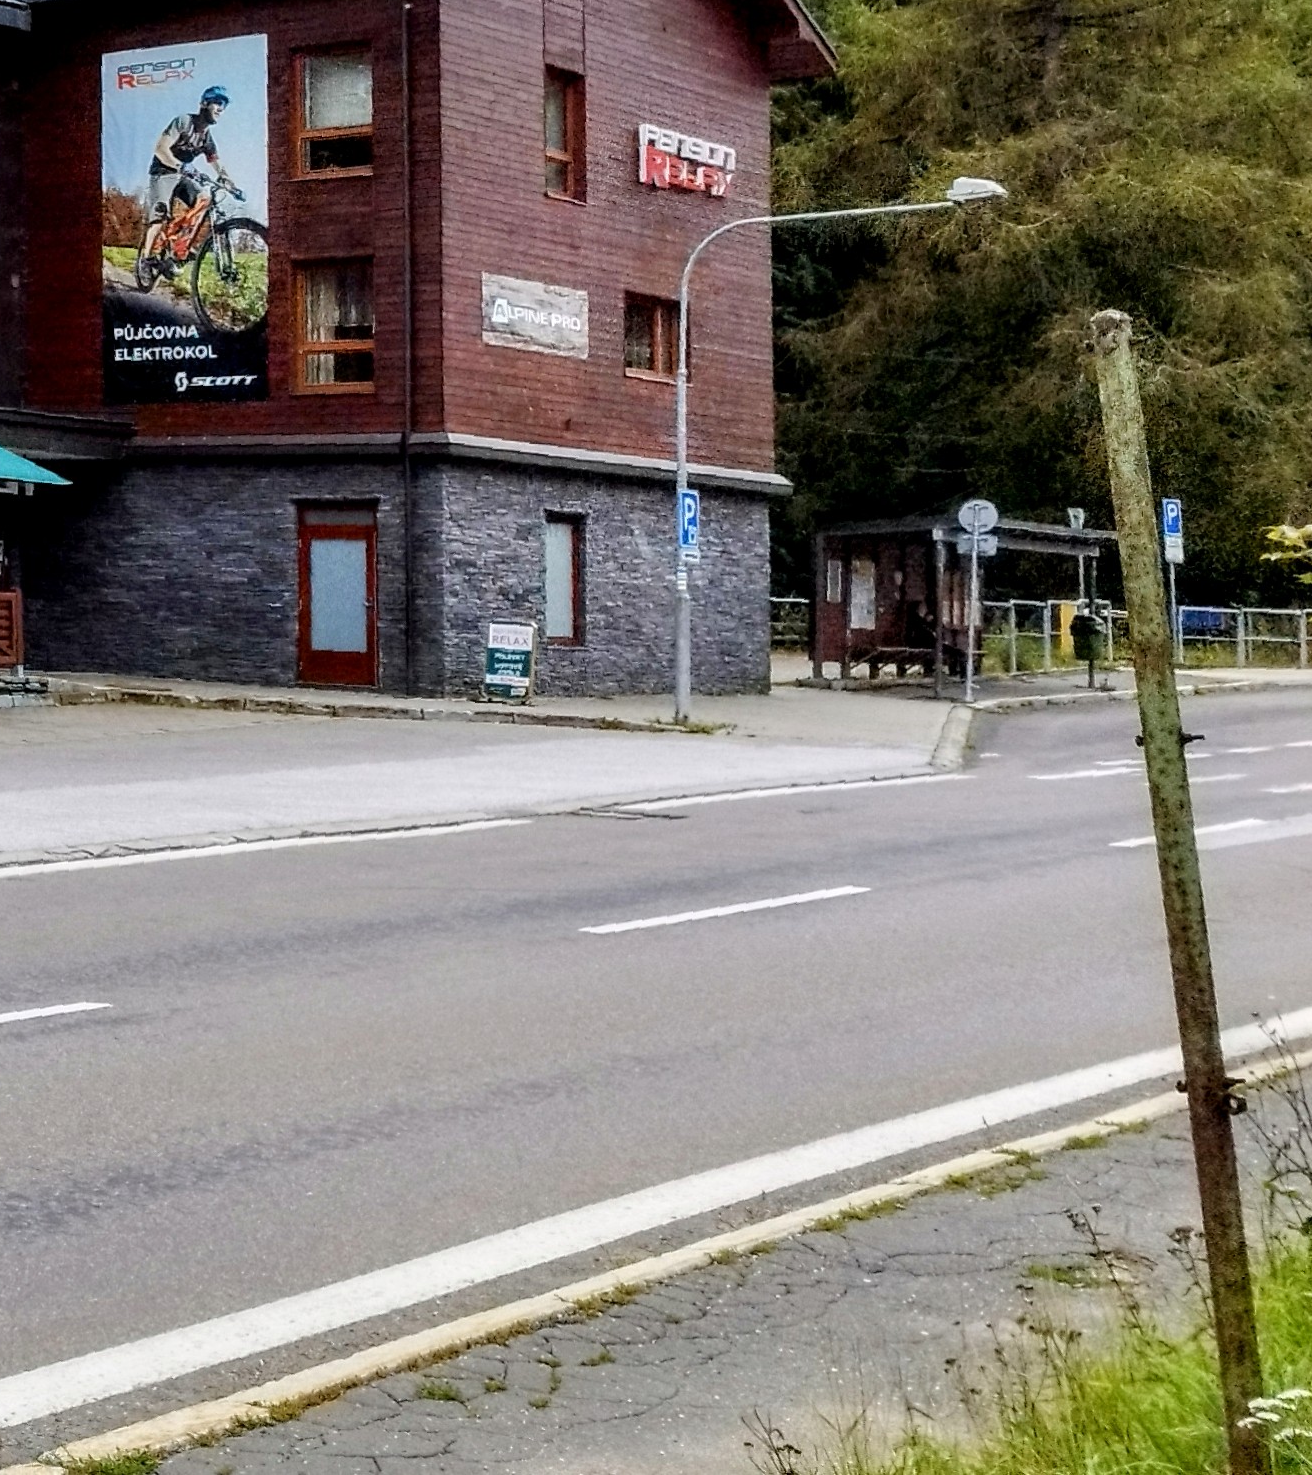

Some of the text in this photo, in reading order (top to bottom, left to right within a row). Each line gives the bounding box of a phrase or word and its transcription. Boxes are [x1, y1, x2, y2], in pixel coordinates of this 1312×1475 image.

[117, 58, 195, 75] PENSION
[117, 70, 194, 90] RELAX
[639, 123, 736, 171] PENSION
[639, 145, 735, 198] RELAX
[491, 297, 580, 331] ALPINE PRO
[114, 324, 199, 340] PŮJČOVNA
[114, 345, 218, 361] ELEKTROKOL
[188, 375, 257, 386] SCOTT
[684, 497, 696, 531] P
[1167, 504, 1177, 525] P
[492, 635, 529, 646] RELAX
